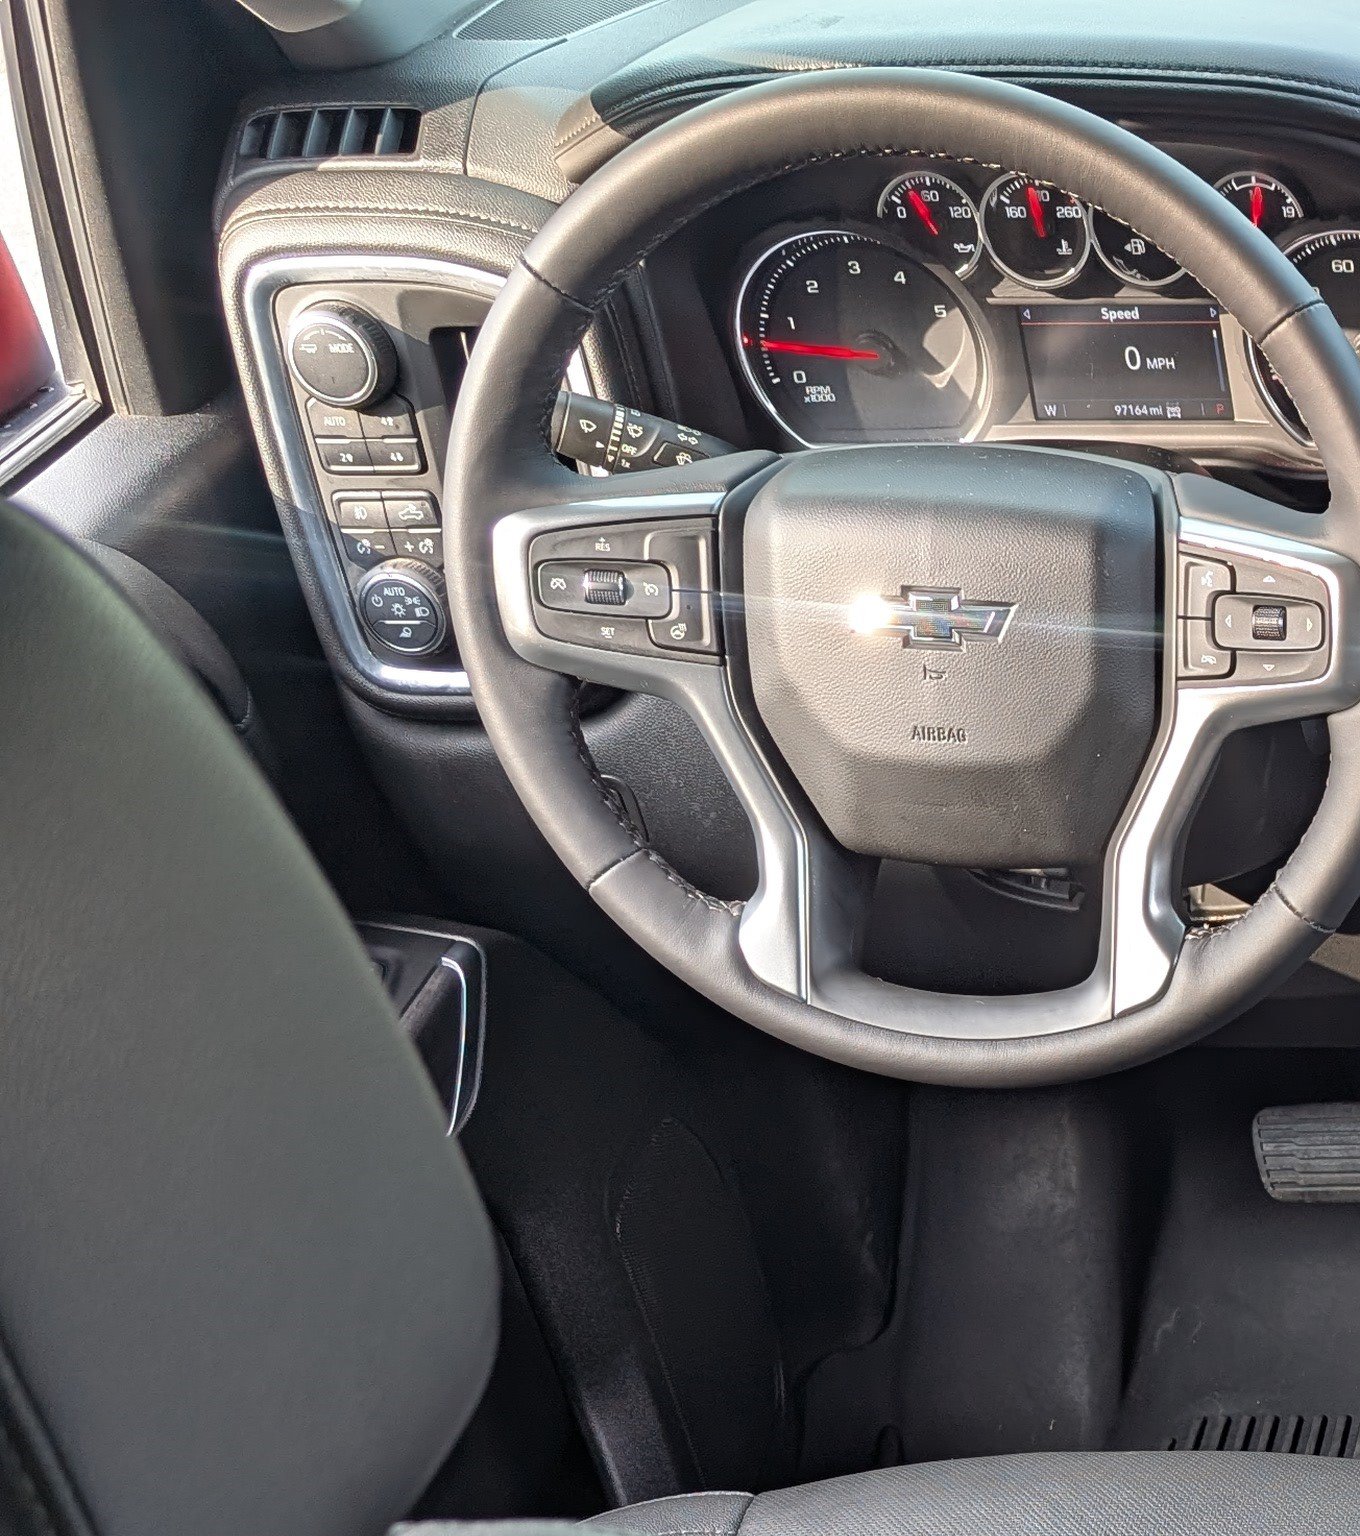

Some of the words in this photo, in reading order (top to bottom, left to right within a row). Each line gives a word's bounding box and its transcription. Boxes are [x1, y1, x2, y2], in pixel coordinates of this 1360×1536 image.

[897, 207, 907, 219] 0
[950, 207, 972, 219] 120
[1005, 206, 1027, 218] 160
[1056, 206, 1081, 218] 260
[1282, 206, 1295, 218] 19
[848, 261, 861, 274] 3
[1331, 259, 1355, 273] 60
[894, 271, 906, 284] 4
[806, 280, 819, 293] 2
[934, 305, 946, 318] 5
[1101, 307, 1140, 322] Speed
[787, 316, 796, 330] 1
[328, 343, 354, 353] MODE
[1125, 346, 1141, 370] 0
[1147, 358, 1175, 370] MPH
[793, 370, 806, 384] 0
[805, 386, 831, 395] RPM
[1044, 405, 1057, 417] W
[1115, 404, 1148, 416] 97164
[1149, 404, 1163, 416] mi
[324, 416, 346, 426] AUTO
[622, 444, 637, 455] OFF
[595, 543, 611, 552] RES
[384, 587, 405, 596] AUTO
[601, 627, 615, 636] SET
[911, 725, 967, 742] AIRBAG
